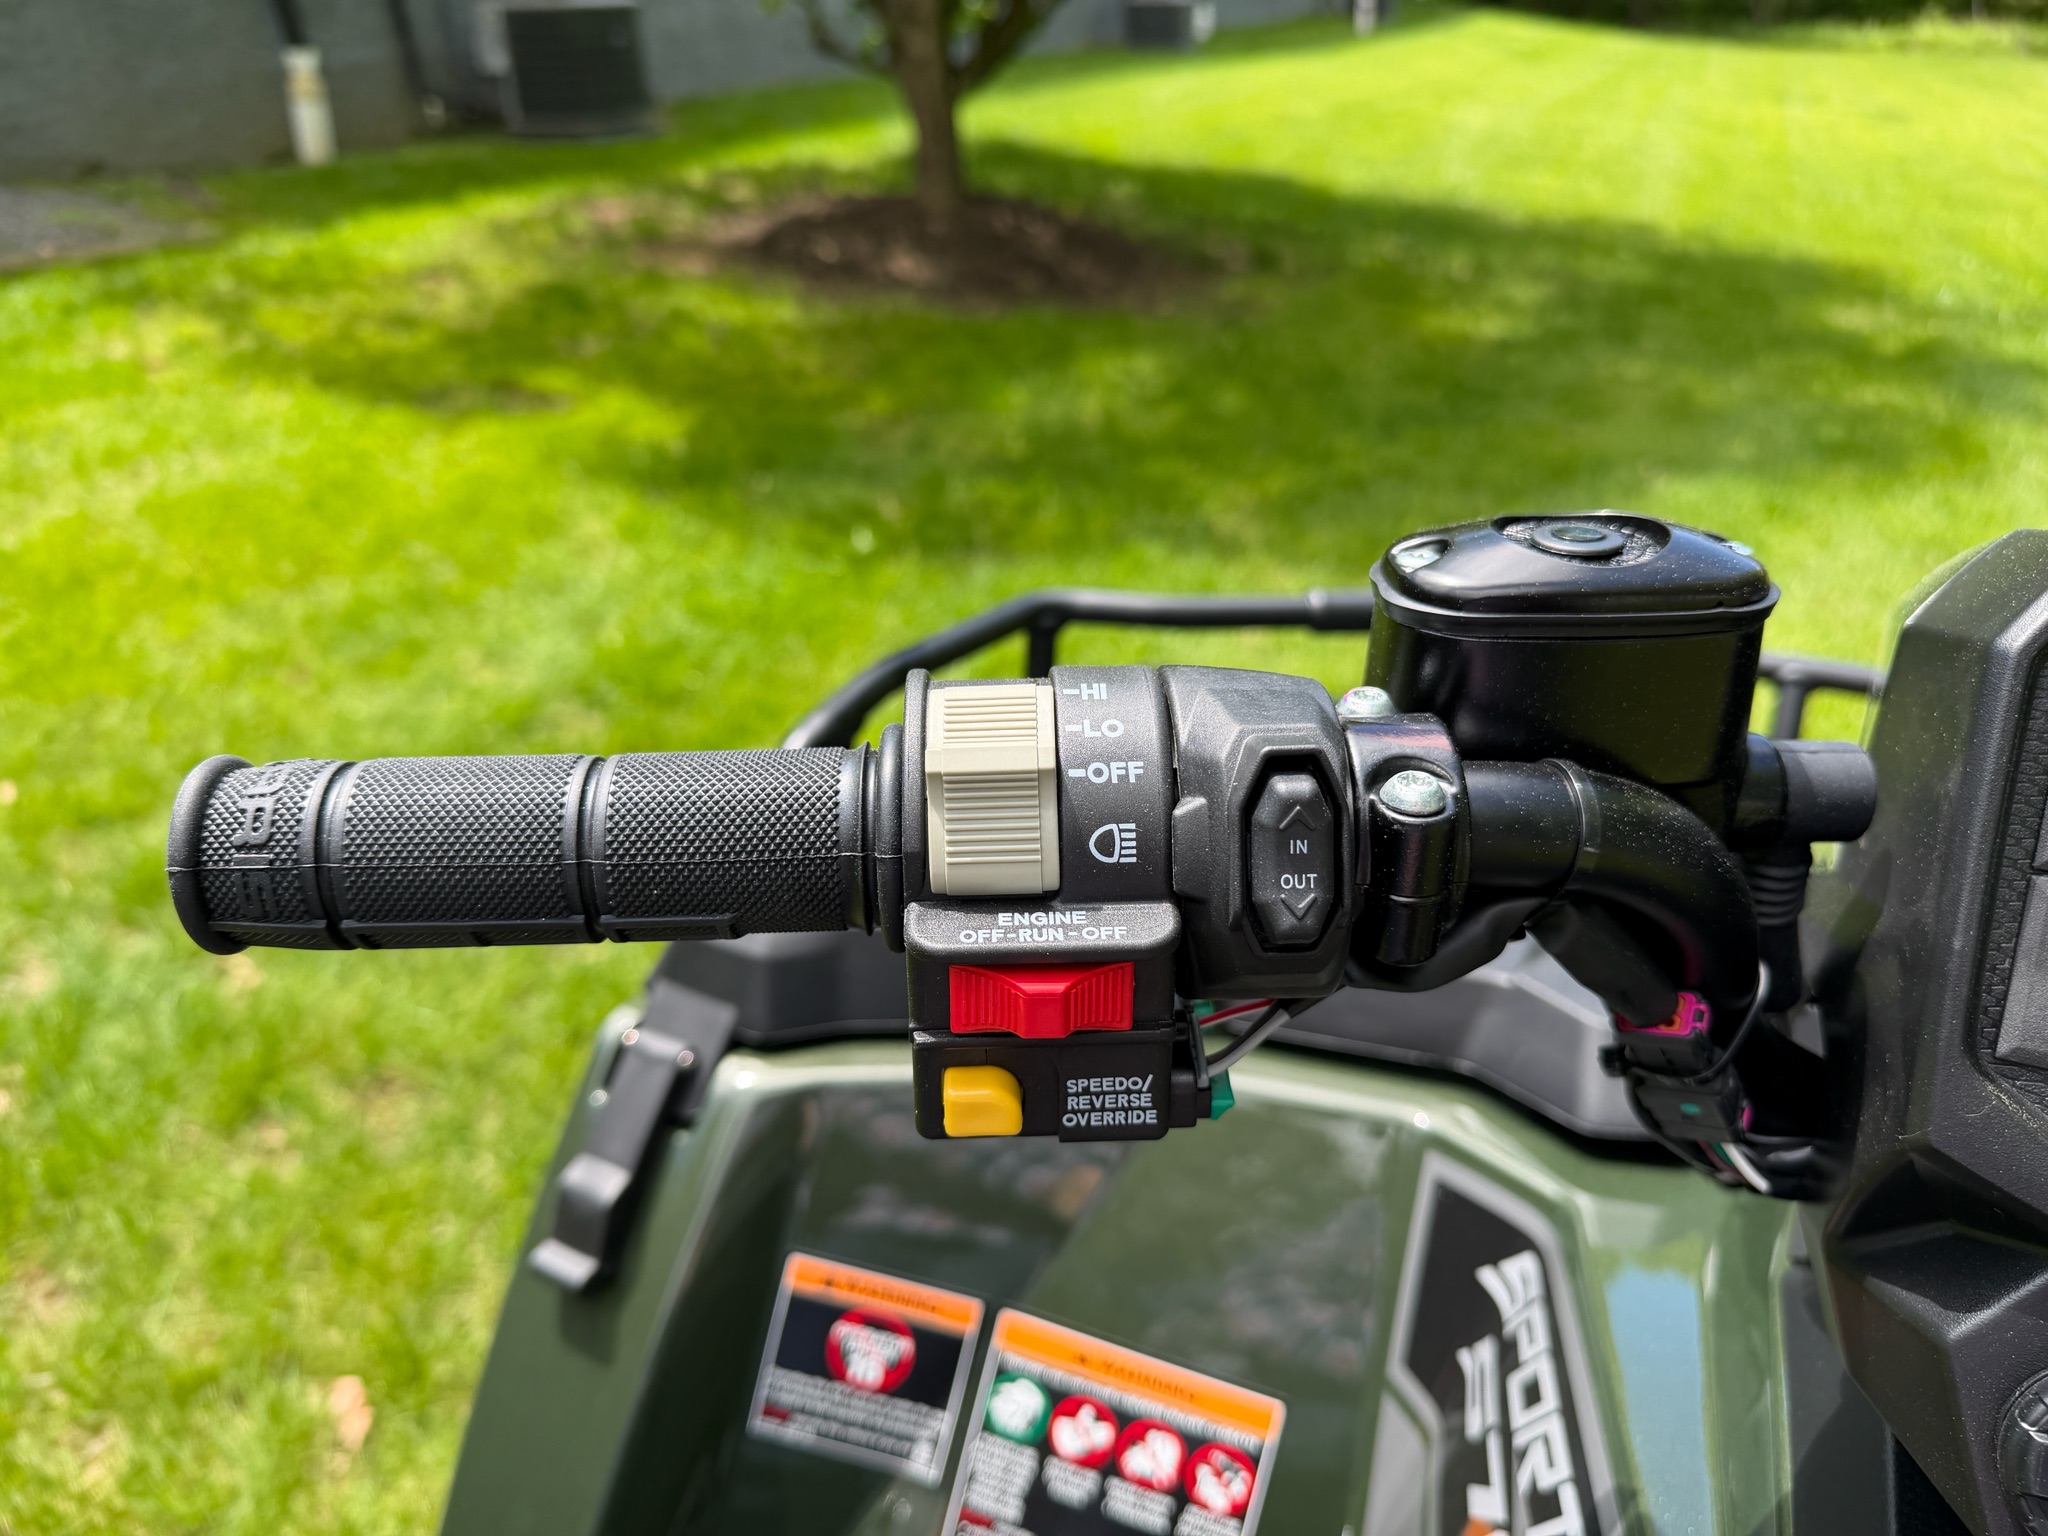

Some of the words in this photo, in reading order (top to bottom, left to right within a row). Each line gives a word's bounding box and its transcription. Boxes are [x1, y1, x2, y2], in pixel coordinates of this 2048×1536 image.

[1289, 839, 1308, 854] IN
[1280, 873, 1318, 889] OUT
[998, 910, 1087, 926] ENGINE
[1066, 1073, 1154, 1093] SPEEDO/
[1067, 1093, 1152, 1110] REVERSE
[1062, 1109, 1158, 1127] OVERRIDE
